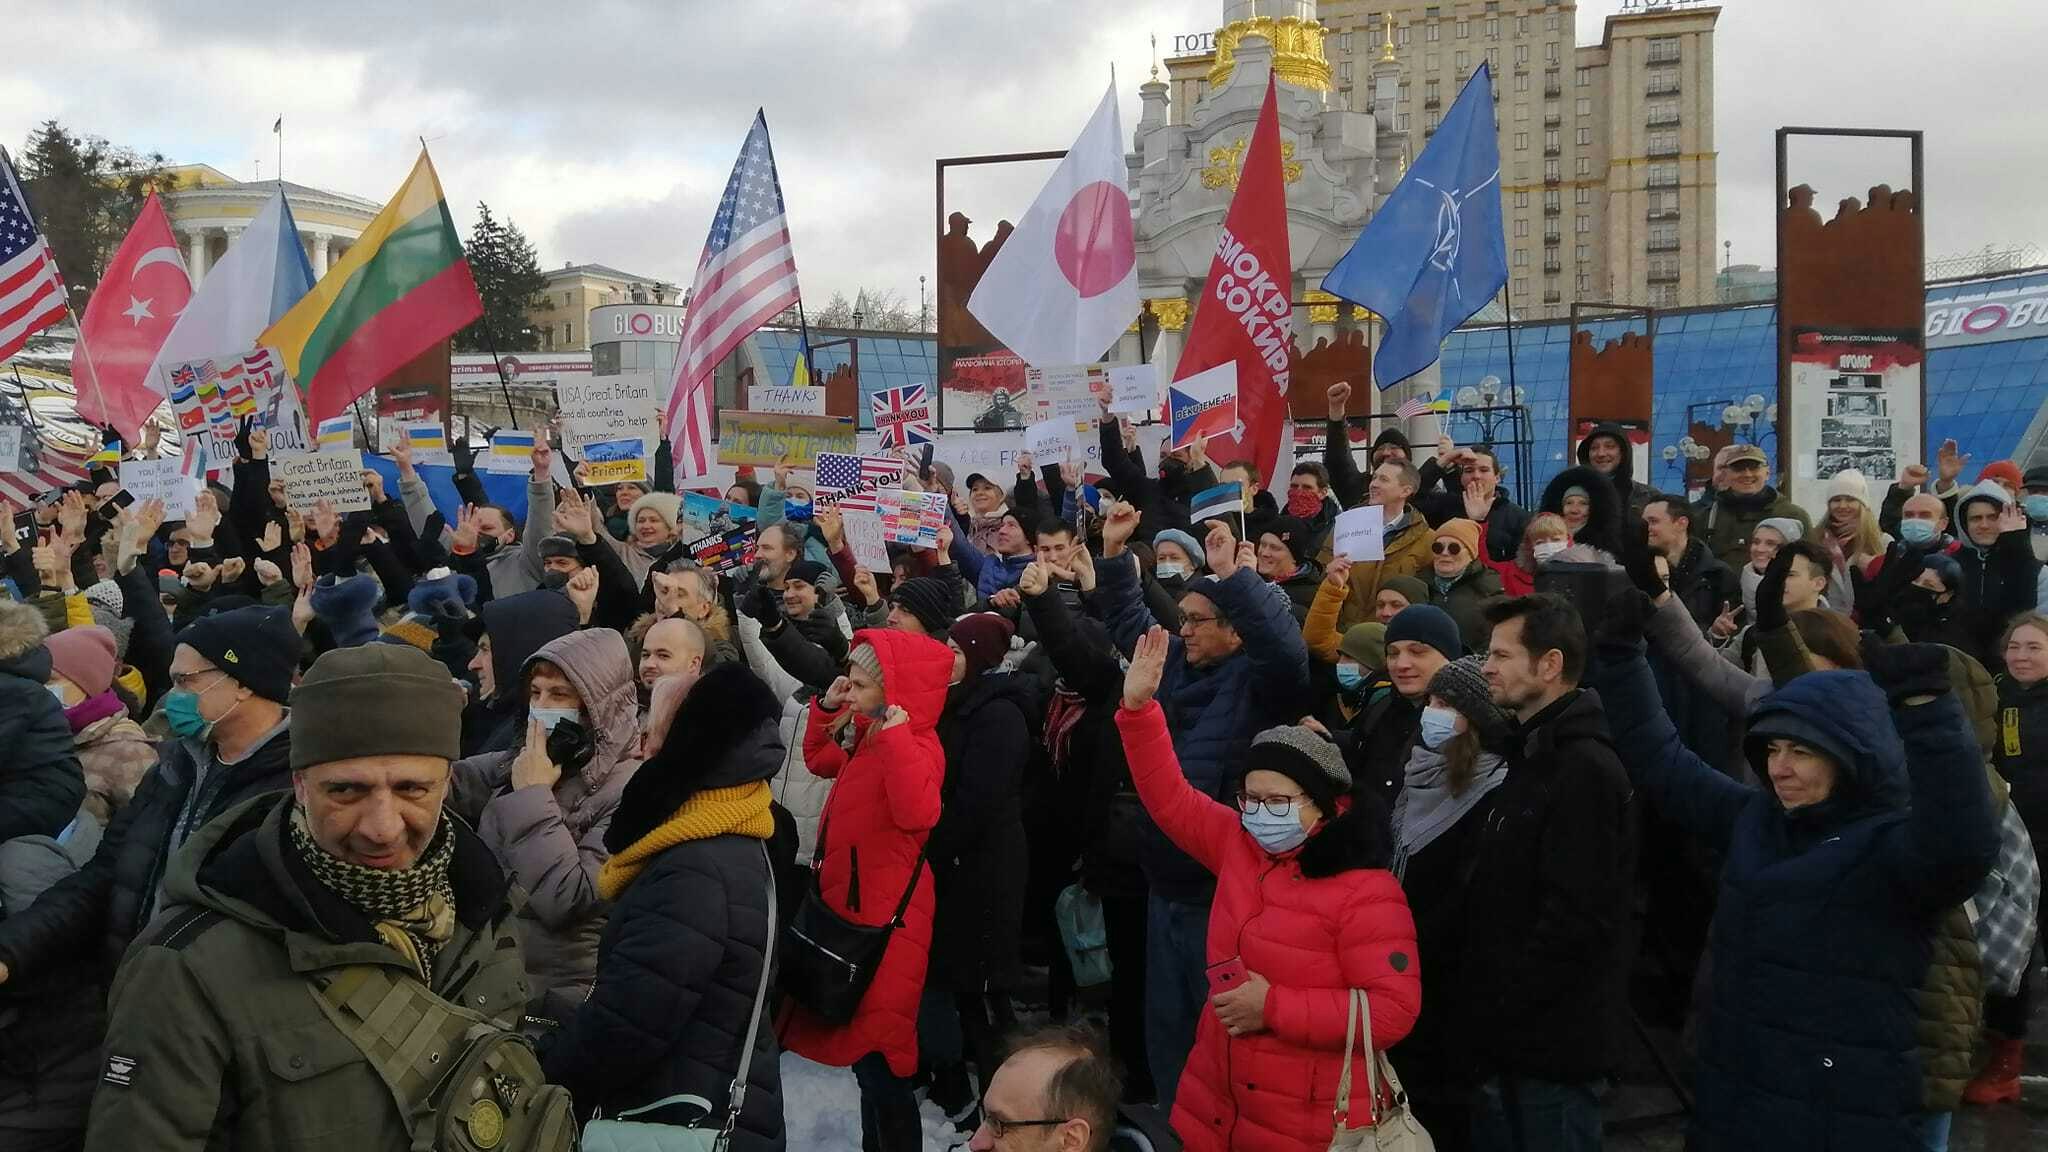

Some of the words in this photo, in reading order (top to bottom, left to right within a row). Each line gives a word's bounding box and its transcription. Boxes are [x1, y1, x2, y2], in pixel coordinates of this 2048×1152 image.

[1216, 227, 1292, 351] ЕМОКРА
[1925, 297, 2048, 338] GLOBU
[1217, 273, 1290, 397] СОКИРА
[451, 365, 483, 374] ariman
[584, 383, 612, 401] Great
[614, 383, 649, 401] Britain
[764, 389, 818, 404] THANKS
[587, 407, 624, 418] countries
[904, 409, 925, 418] YOU
[606, 418, 625, 428] who
[627, 416, 648, 427] help
[138, 469, 154, 477] YOU
[283, 460, 316, 476] Great
[317, 458, 352, 473] Britain
[592, 463, 637, 477] Friends
[128, 481, 139, 489] ON
[287, 478, 312, 489] you're
[313, 475, 334, 487] really
[816, 481, 869, 507] THANK
[868, 468, 902, 489] YOU
[689, 534, 723, 555] #THANKS
